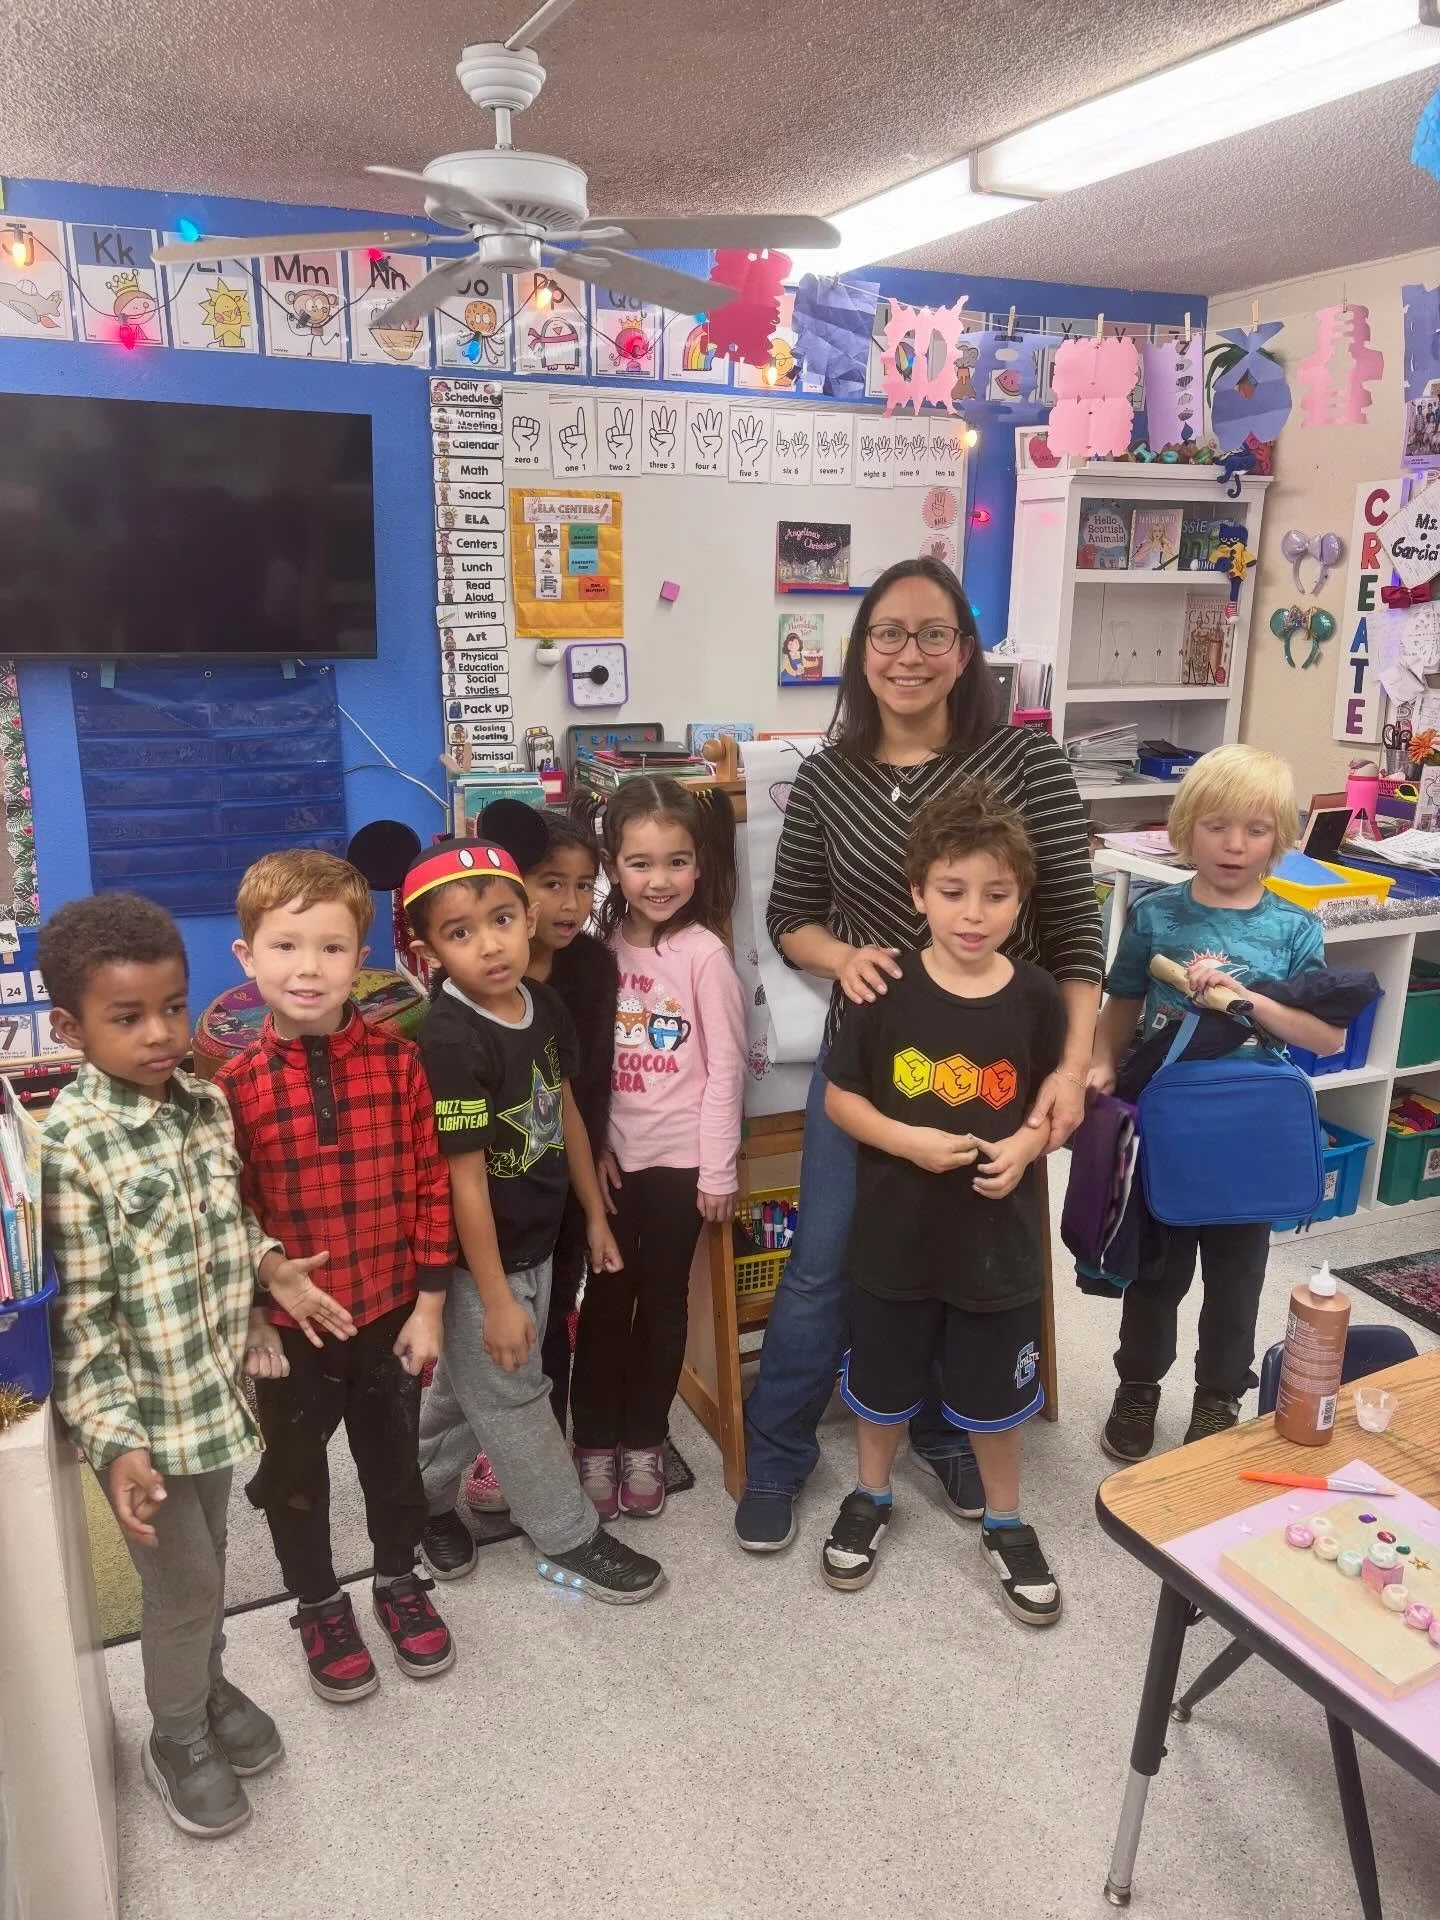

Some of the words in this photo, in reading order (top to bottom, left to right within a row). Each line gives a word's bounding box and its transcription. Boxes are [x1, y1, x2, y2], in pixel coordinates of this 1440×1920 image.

[93, 231, 135, 266] Kk
[274, 255, 330, 285] Mm
[533, 272, 565, 311] Pp
[454, 381, 479, 393] Daily
[444, 392, 489, 403] Schedule
[456, 409, 496, 420] Morning
[457, 421, 498, 432] Meeting
[452, 440, 500, 450] Calendar
[533, 456, 539, 464] 0
[460, 465, 489, 475] Math
[695, 462, 710, 470] four
[739, 469, 752, 477] five
[863, 470, 880, 479] eight
[459, 489, 492, 500] Snack
[537, 504, 556, 514] ELA
[558, 504, 601, 514] CENTERS
[464, 514, 490, 524] ELA
[1094, 515, 1117, 525] Hello
[1415, 513, 1438, 530] Ms.
[1088, 524, 1125, 534] Scottish
[1182, 520, 1208, 533] SSIE
[1087, 533, 1126, 543] Animals!
[456, 538, 498, 549] Centers
[461, 562, 493, 572] Lunch
[466, 581, 491, 590] Read
[465, 593, 494, 602] Aloud
[465, 611, 497, 620] Writing
[466, 632, 487, 642] Art
[461, 652, 498, 662] Physical
[458, 664, 504, 672] Education
[466, 674, 497, 683] Social
[464, 686, 500, 695] Studies
[464, 703, 492, 714] Pack
[495, 704, 509, 715] up
[474, 725, 506, 733] Closing
[472, 733, 508, 742] Meeting
[631, 974, 656, 994] MY
[6, 987, 22, 997] 24
[36, 985, 48, 994] 2
[618, 1052, 680, 1074] COCOA
[435, 1099, 461, 1115] BUZZ
[438, 1112, 489, 1132] LIGHTYEAR
